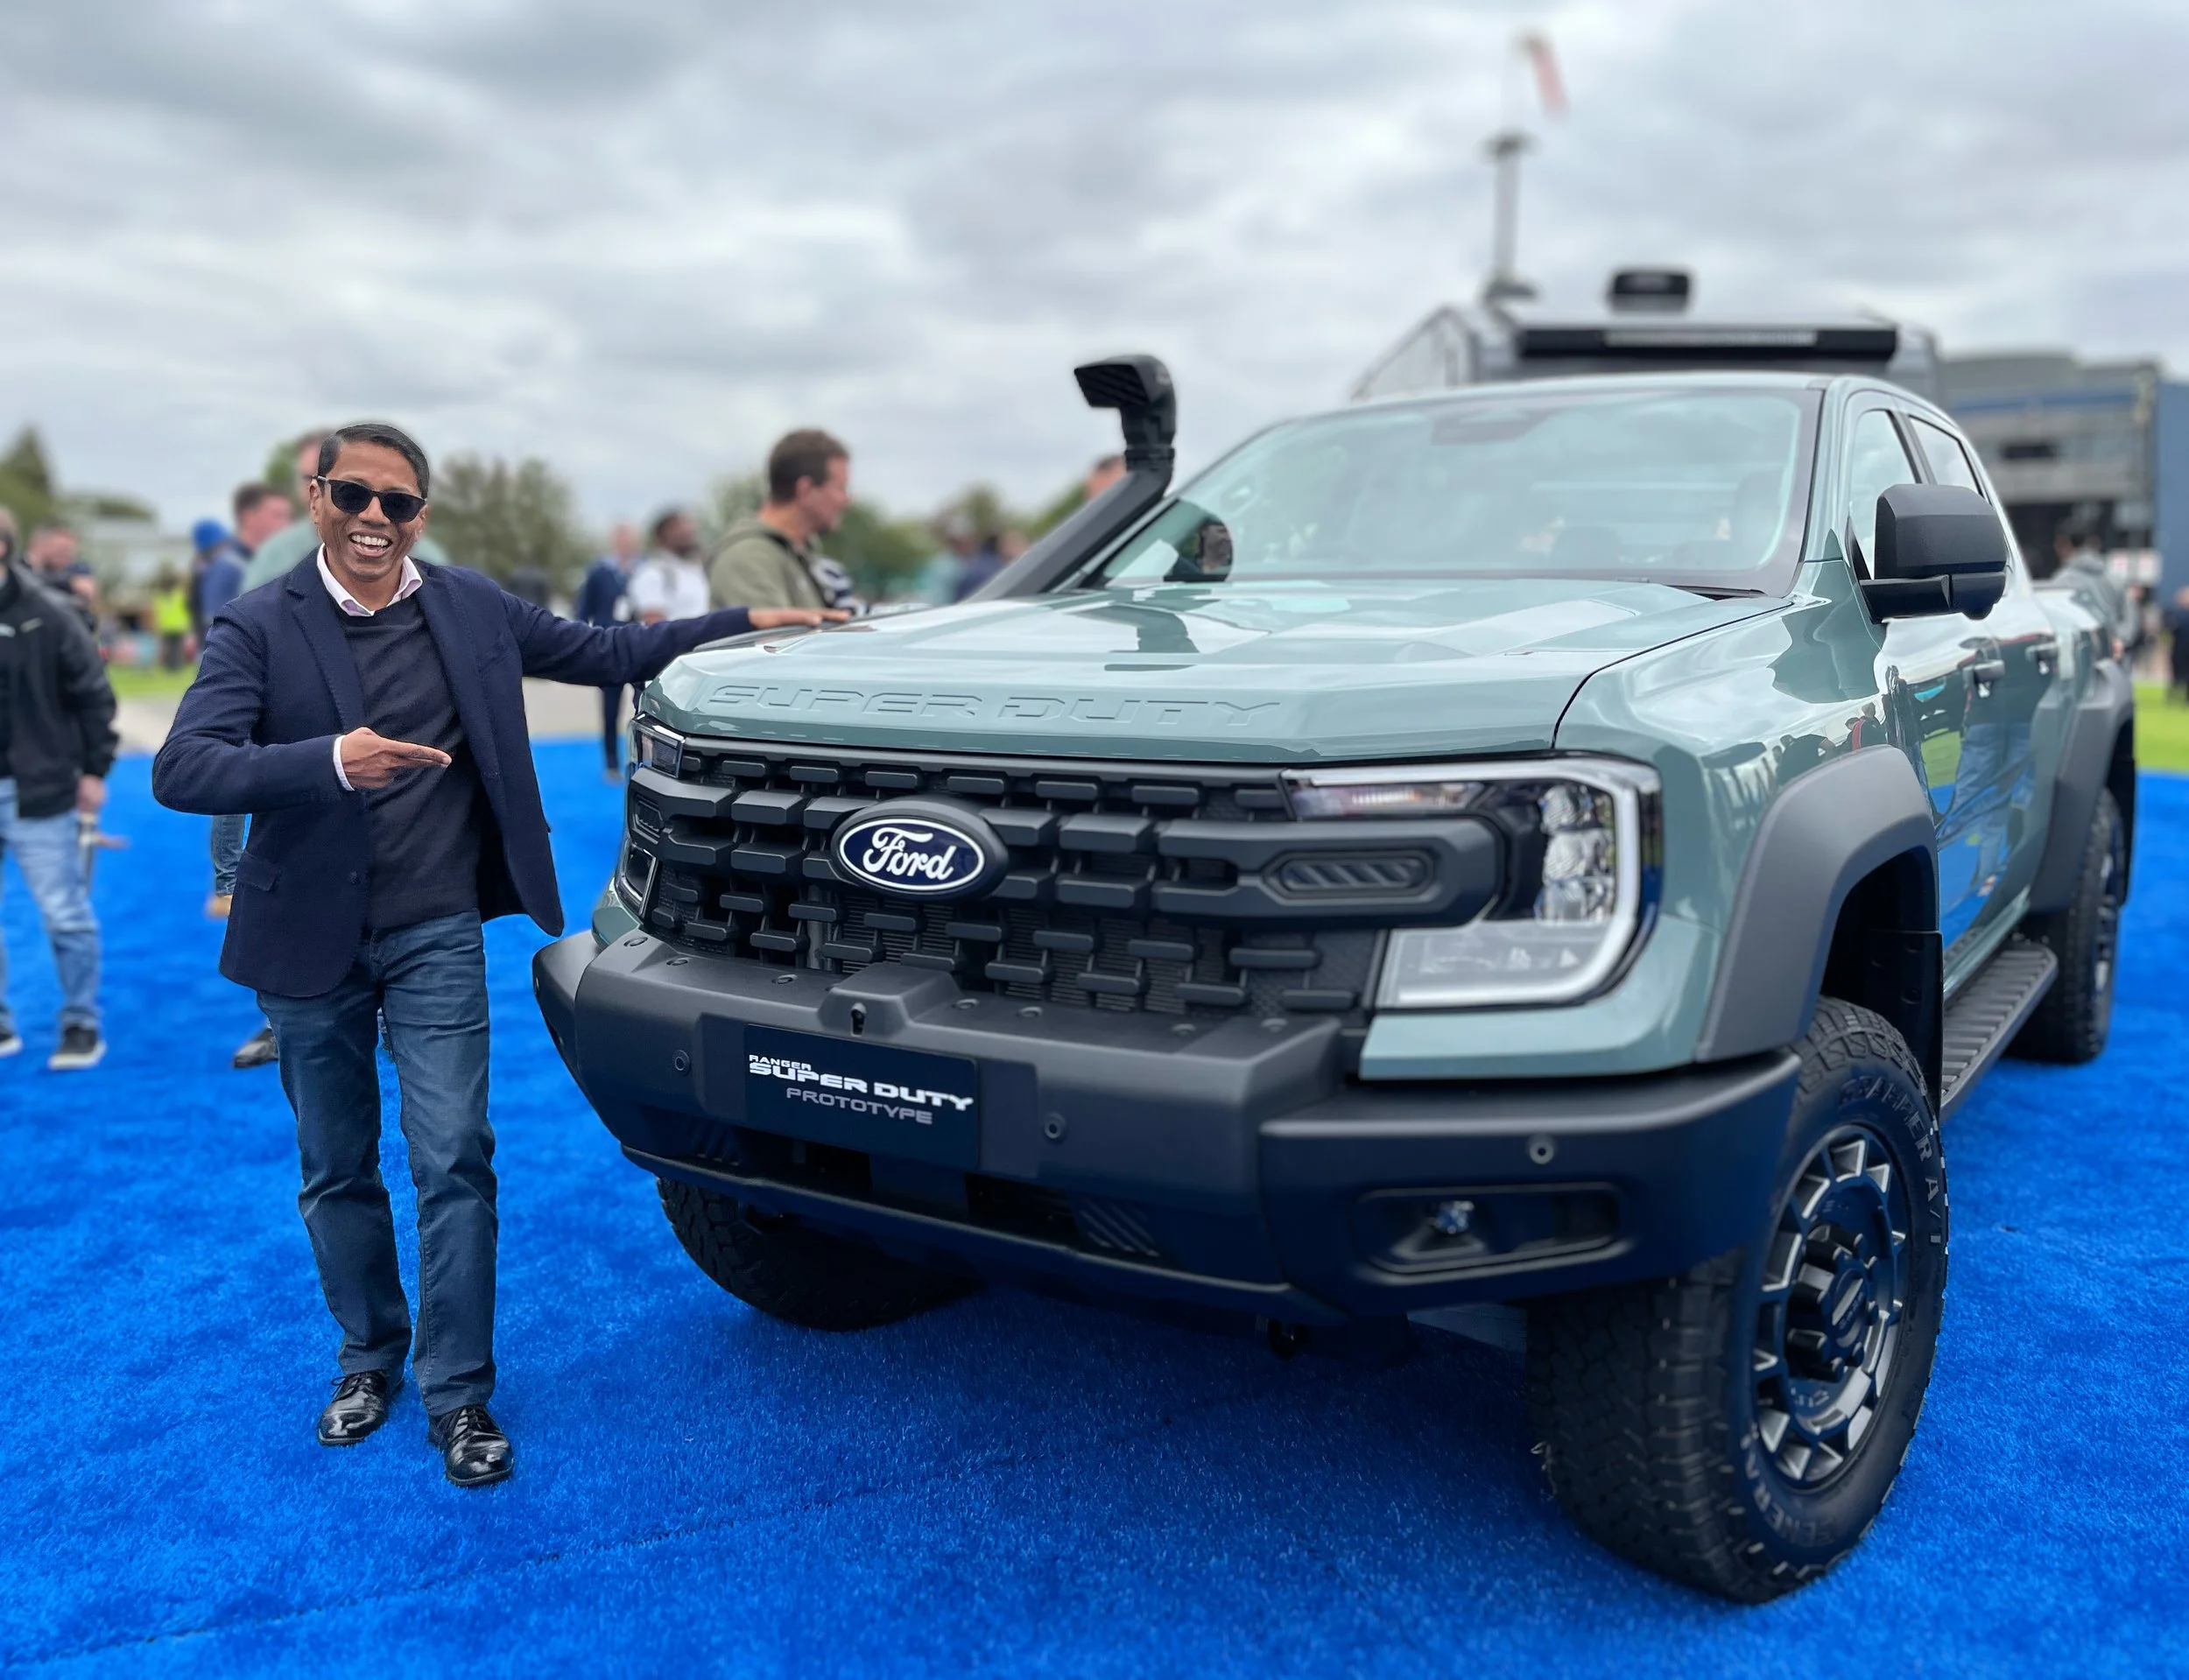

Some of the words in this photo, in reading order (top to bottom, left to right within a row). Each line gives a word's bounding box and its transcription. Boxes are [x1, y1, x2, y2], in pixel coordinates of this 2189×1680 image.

[707, 685, 982, 718] SUPER
[996, 696, 1281, 727] DUTY
[862, 826, 954, 881] Ford
[749, 1054, 812, 1072] RANGER
[749, 1061, 869, 1093] SUPER
[873, 1081, 975, 1111] DUTY
[785, 1086, 933, 1125] PROTOTYPE
